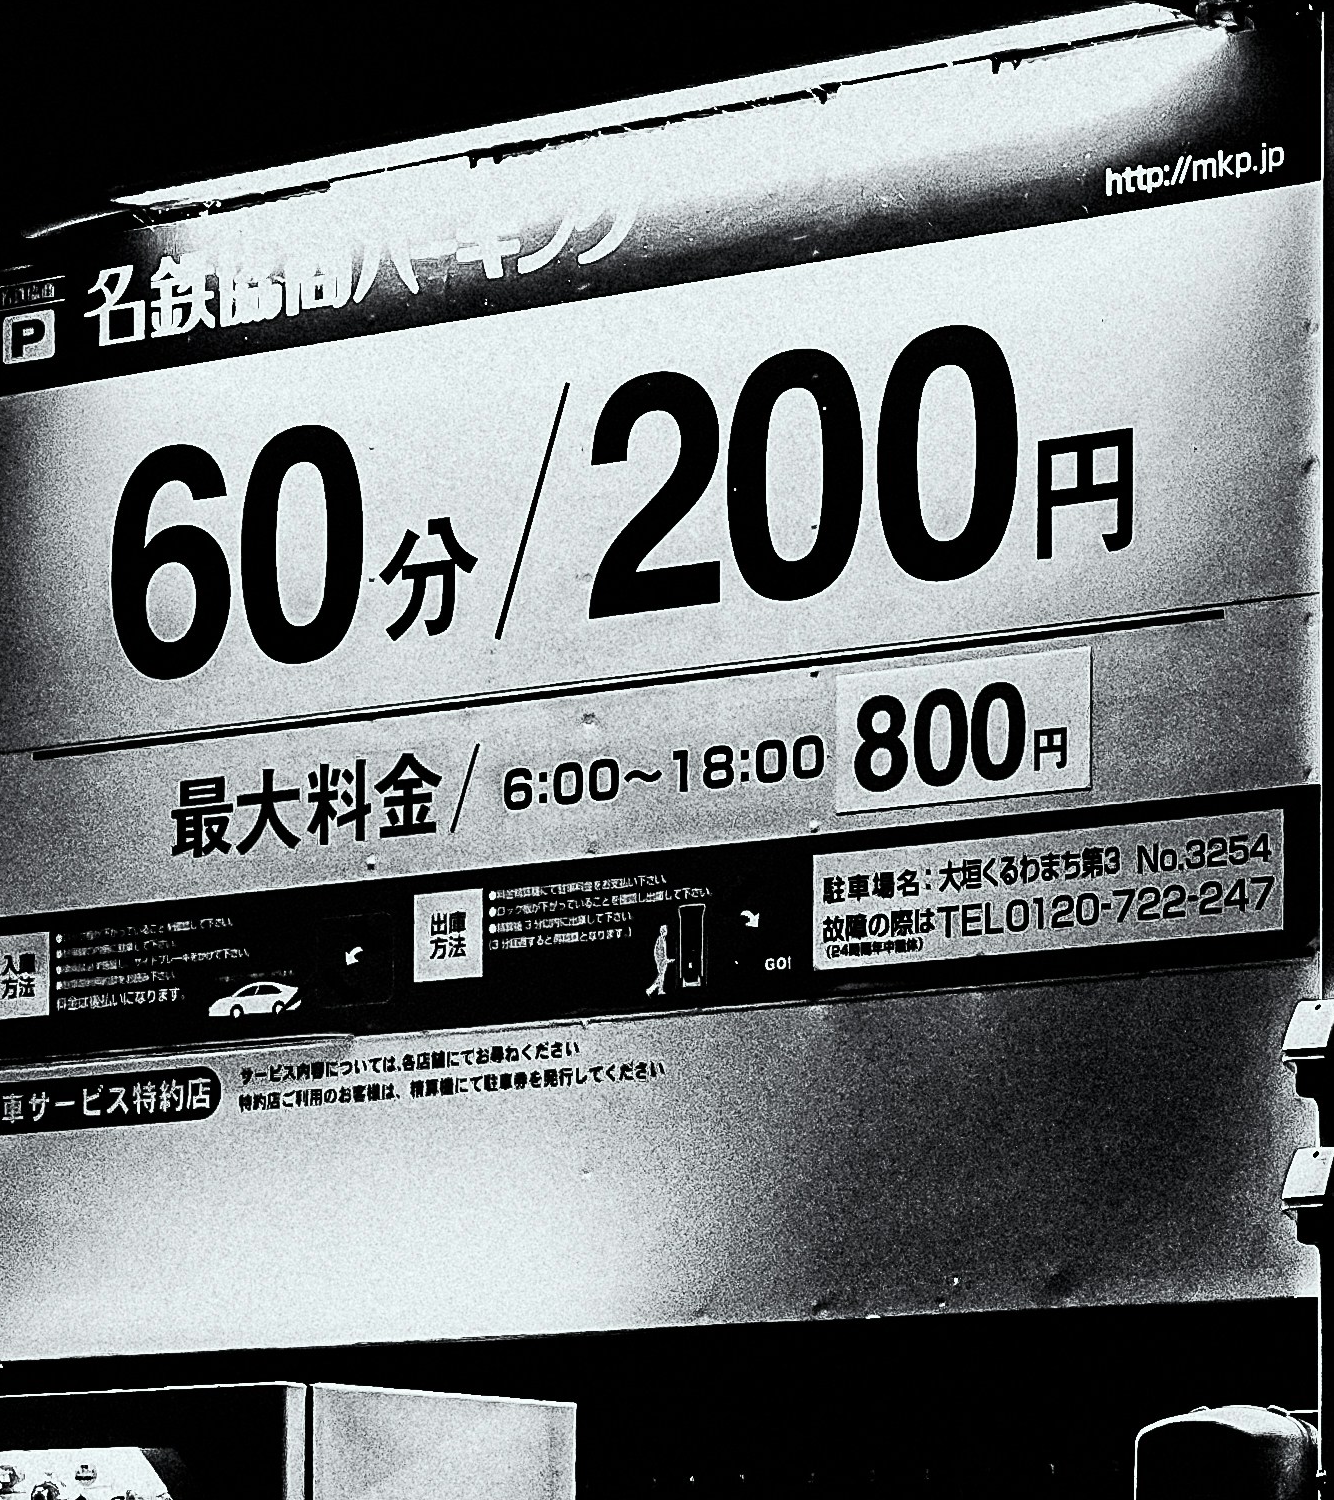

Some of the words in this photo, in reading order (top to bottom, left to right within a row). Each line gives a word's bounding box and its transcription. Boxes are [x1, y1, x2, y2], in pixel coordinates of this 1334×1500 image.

[1105, 142, 1285, 197] http://mkp.jp
[12, 319, 46, 358] P
[854, 682, 1067, 792] 800円
[1137, 833, 1272, 875] No.3254
[430, 934, 466, 959] 方法
[0, 953, 36, 977] 入
[764, 956, 793, 971] GO!
[1, 976, 36, 1000] 方法
